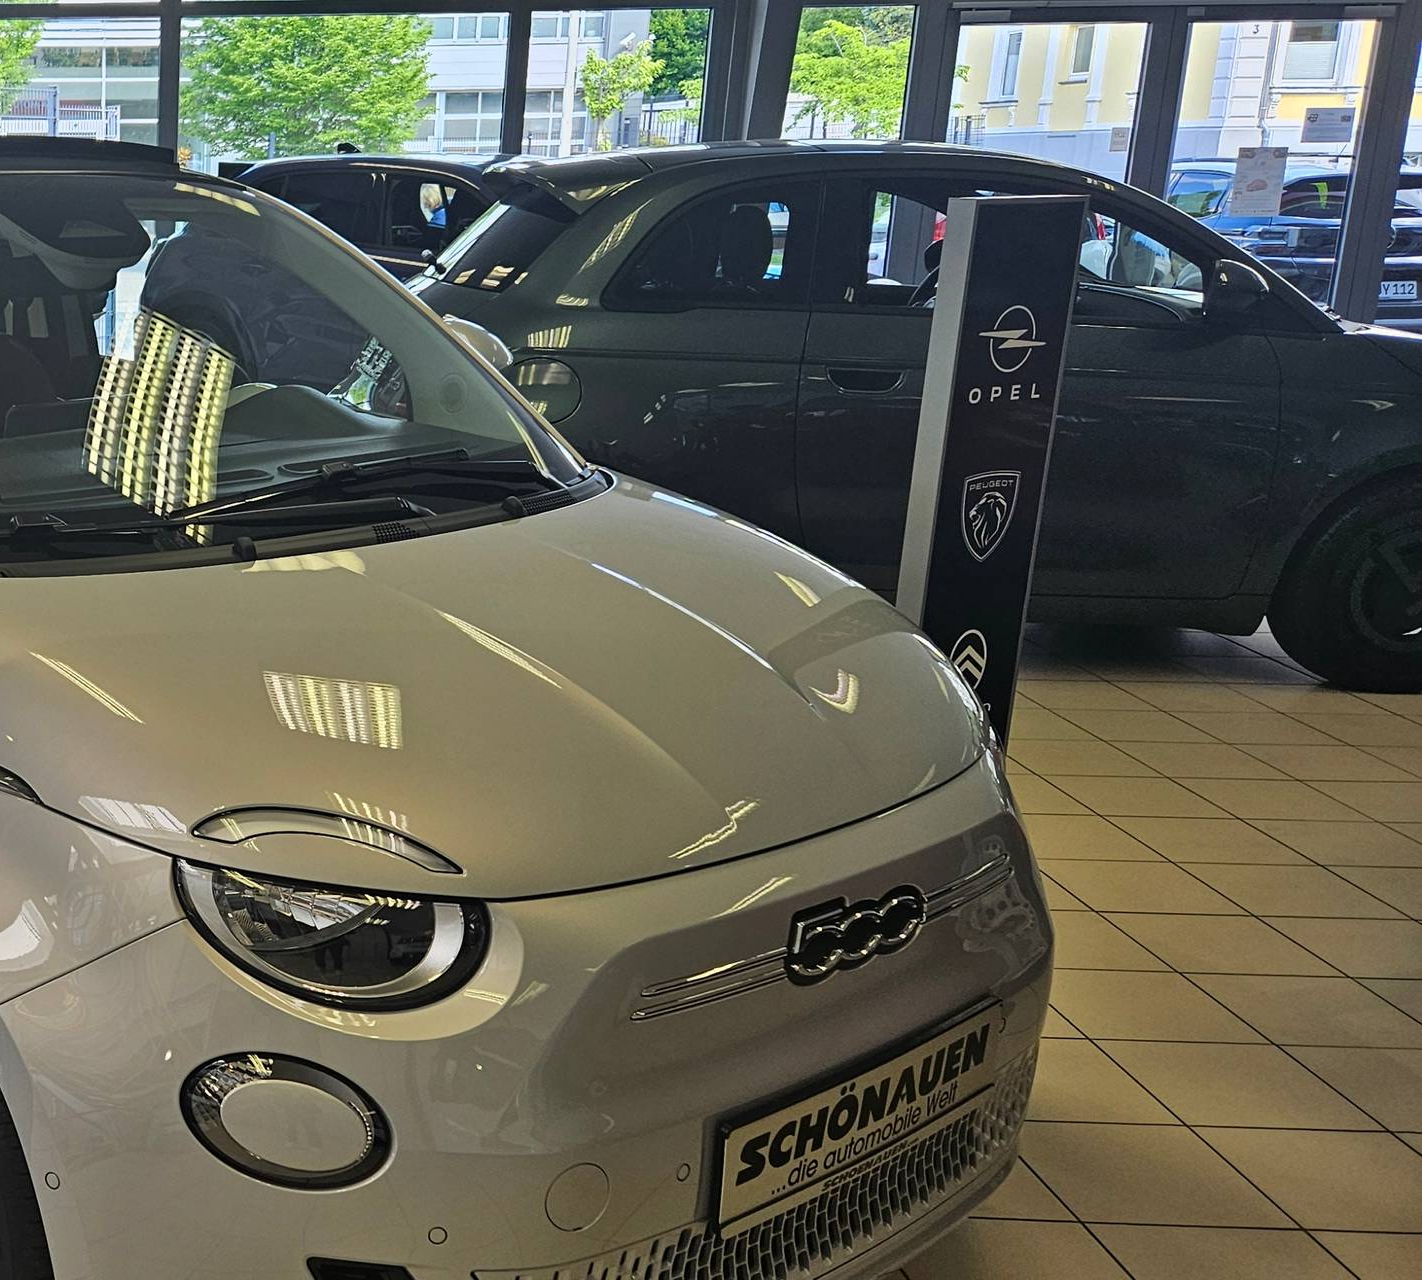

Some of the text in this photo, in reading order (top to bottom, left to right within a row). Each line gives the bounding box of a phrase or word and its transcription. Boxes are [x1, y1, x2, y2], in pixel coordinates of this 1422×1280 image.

[1252, 24, 1260, 34] 3
[1392, 283, 1415, 296] 112
[968, 383, 1041, 404] OPEL
[969, 479, 1015, 491] PEUGEOT
[785, 884, 928, 987] 500
[735, 1023, 991, 1187] SCHÖNAUEN
[822, 1106, 922, 1170] automobile
[926, 1081, 959, 1118] Welt
